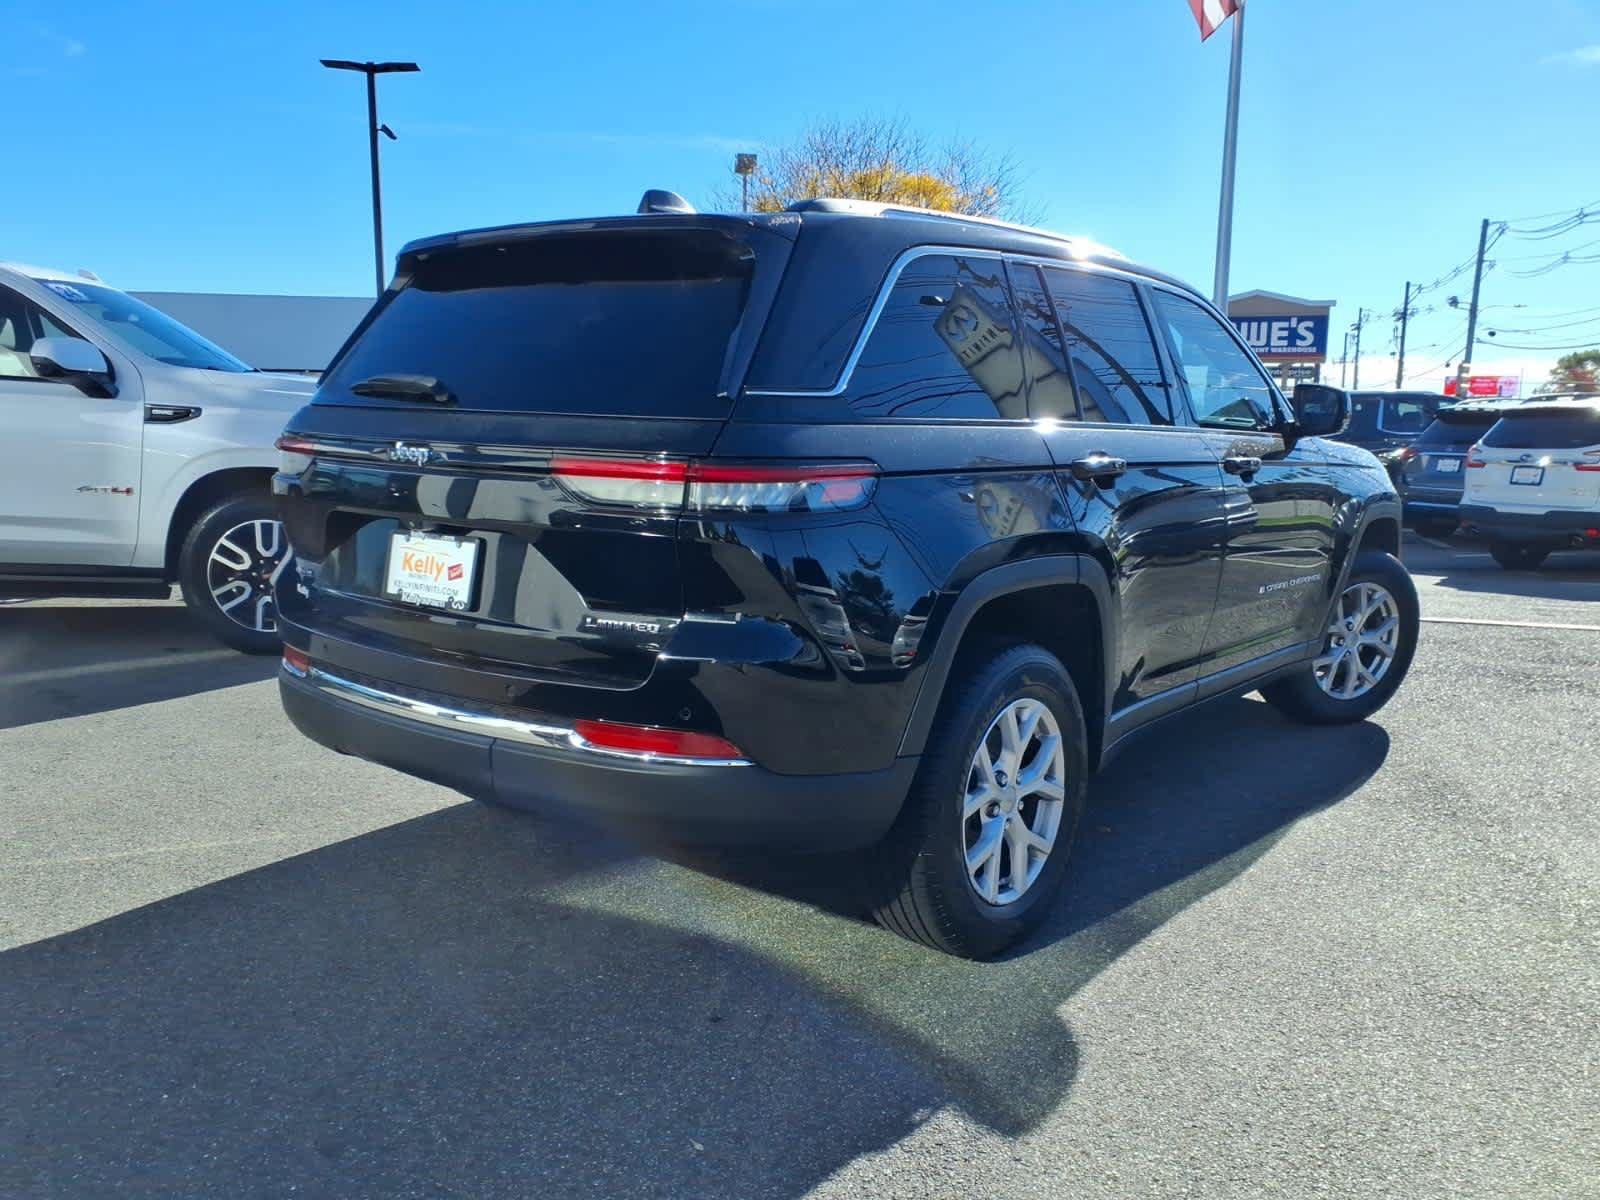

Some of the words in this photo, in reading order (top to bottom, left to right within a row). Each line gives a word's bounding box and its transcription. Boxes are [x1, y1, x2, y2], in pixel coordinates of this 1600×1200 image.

[1232, 317, 1314, 346] WE'S
[391, 441, 428, 467] Jeep
[402, 551, 445, 582] Kelly
